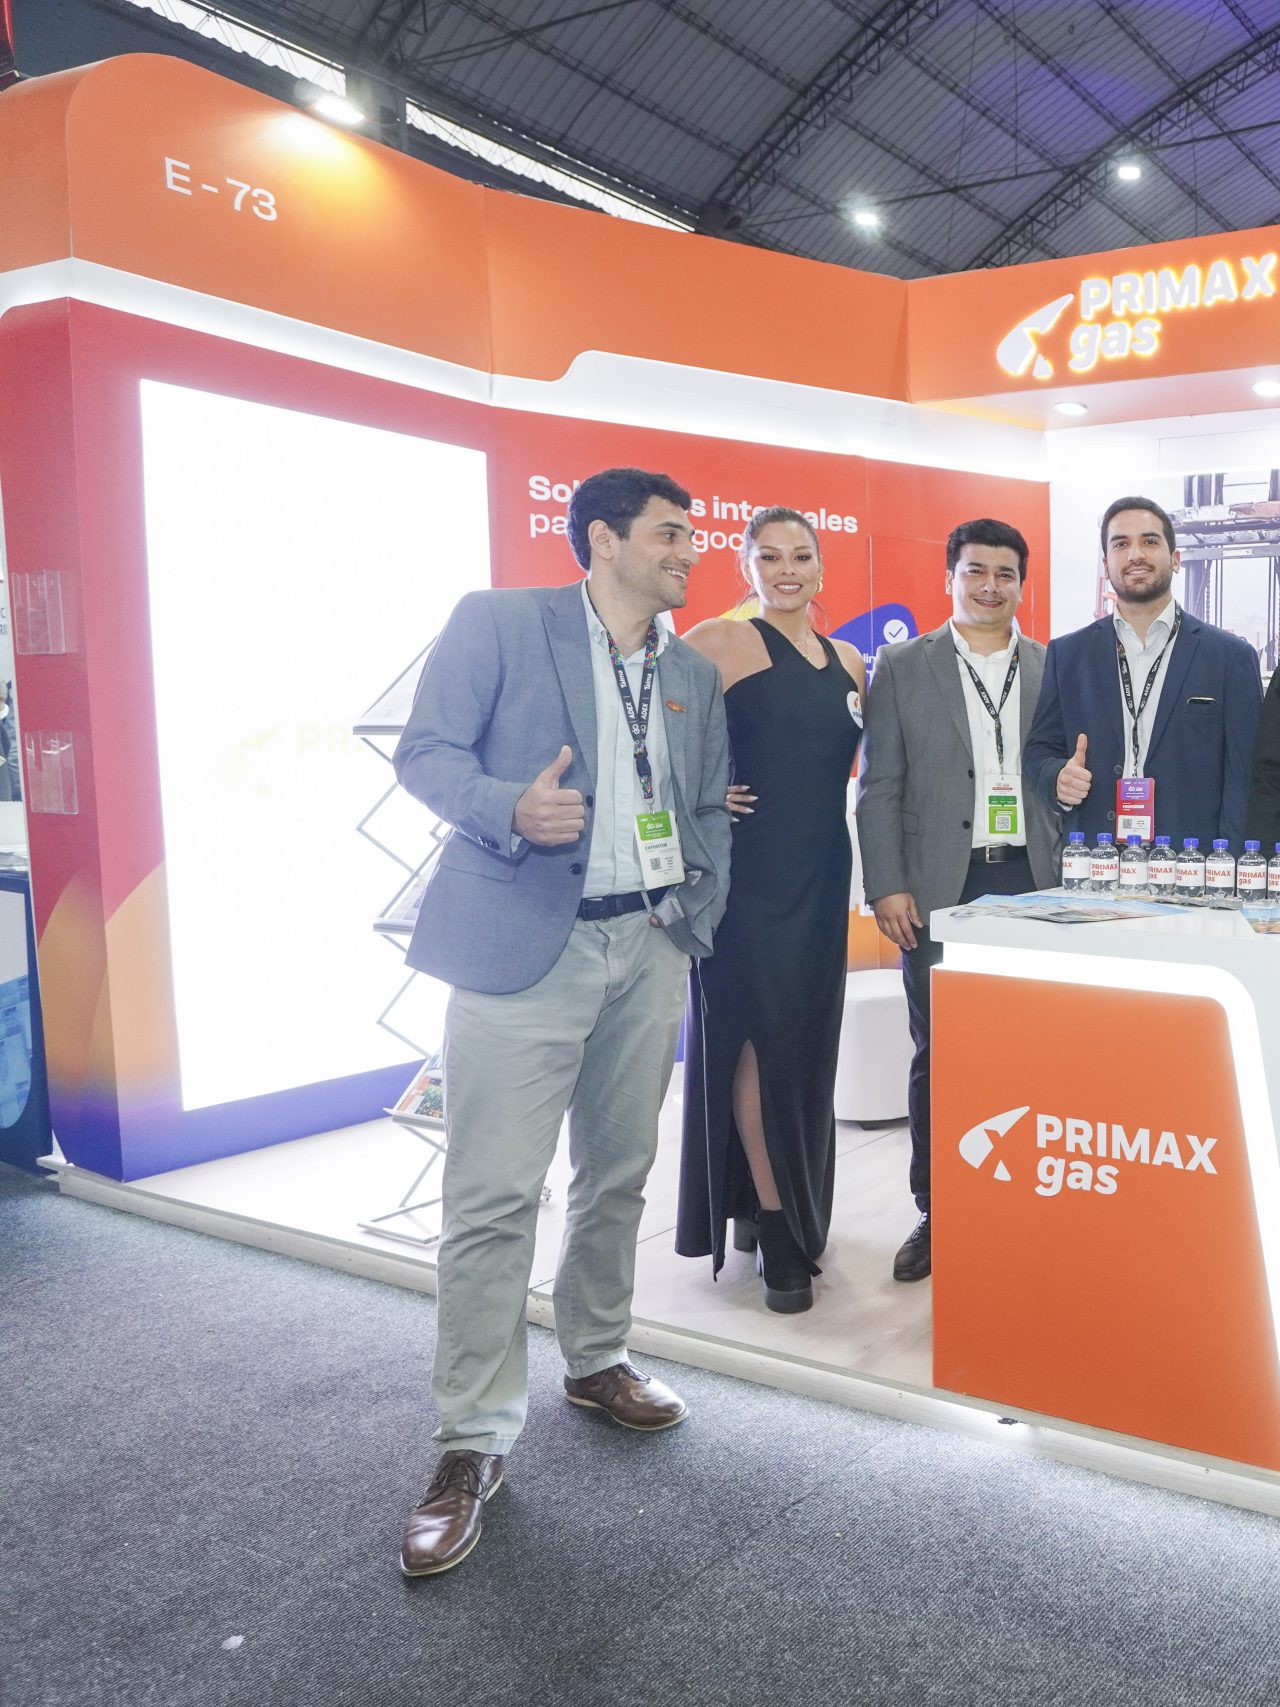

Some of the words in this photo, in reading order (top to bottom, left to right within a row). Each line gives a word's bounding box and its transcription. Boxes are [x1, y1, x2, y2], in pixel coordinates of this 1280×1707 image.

[165, 156, 192, 195] E
[226, 177, 278, 221] 73
[1080, 252, 1277, 320] PRIMAX
[1067, 318, 1162, 373] gas
[626, 702, 635, 719] ADEX
[1037, 1113, 1218, 1175] PRIMAX
[1034, 1155, 1120, 1197] gas
